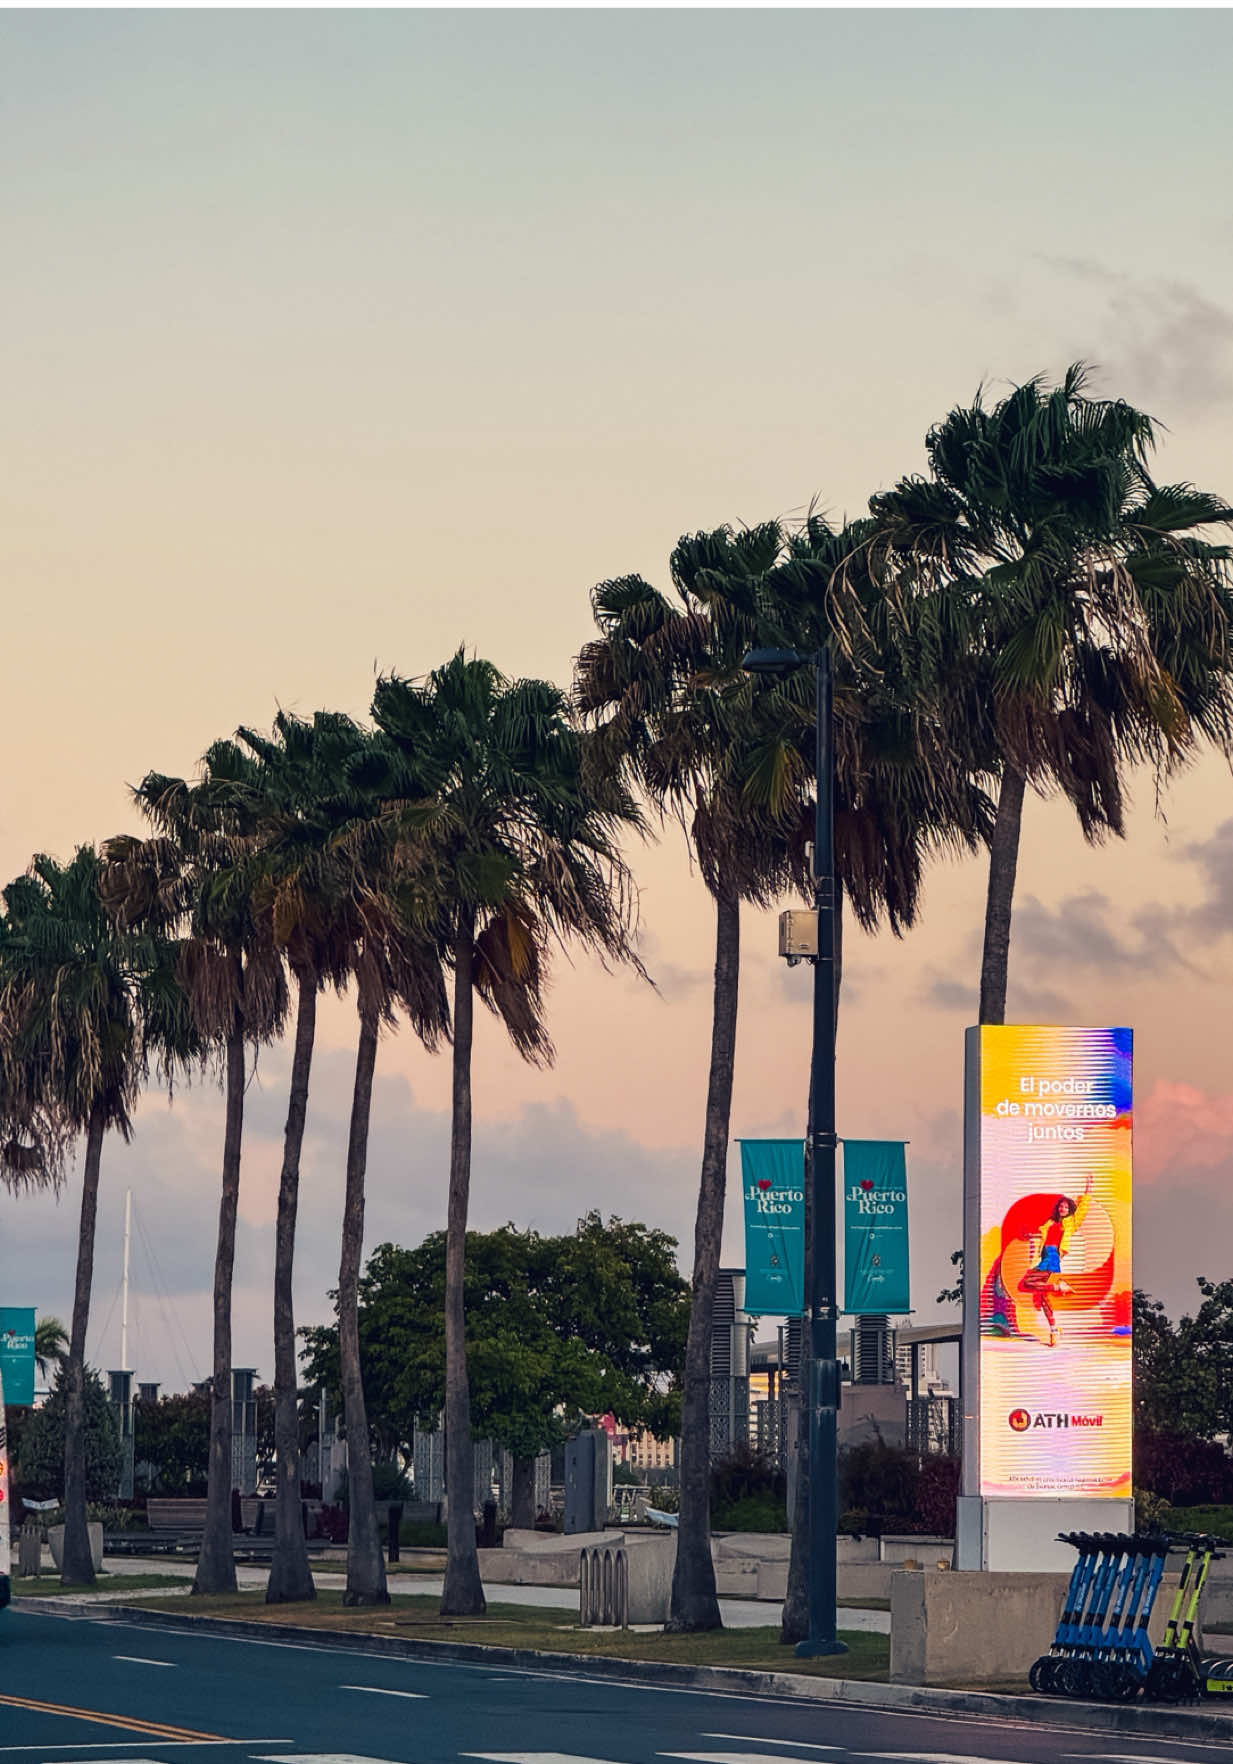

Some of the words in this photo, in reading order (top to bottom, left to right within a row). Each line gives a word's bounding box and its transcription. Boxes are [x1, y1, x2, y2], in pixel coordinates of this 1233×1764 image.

[1020, 1077, 1034, 1093] El
[1039, 1077, 1093, 1096] poder
[996, 1099, 1020, 1115] de
[1024, 1102, 1117, 1117] movernos
[1028, 1122, 1085, 1143] juntos
[745, 1185, 804, 1202] Puerto
[846, 1186, 906, 1202] Puerto
[757, 1200, 792, 1214] Rico
[858, 1200, 895, 1214] Rico
[1033, 1413, 1069, 1428] ATH
[1071, 1414, 1104, 1427] Móvil
